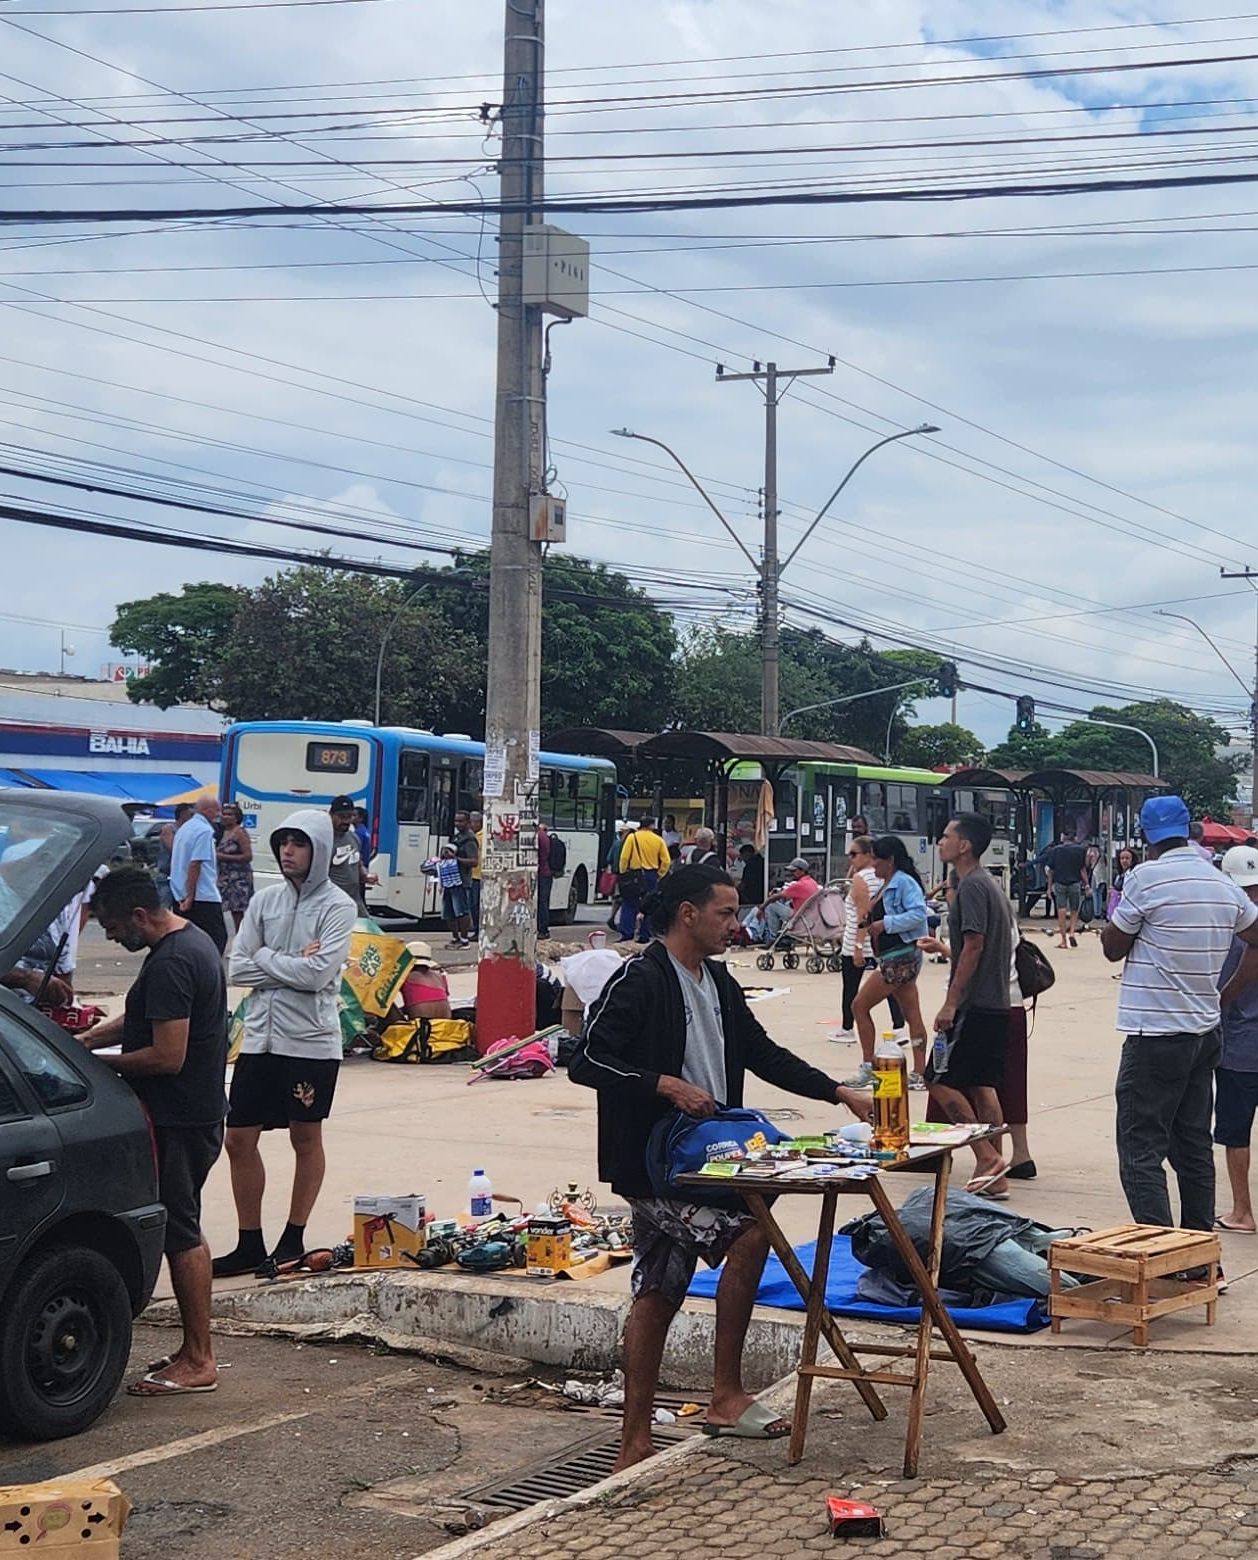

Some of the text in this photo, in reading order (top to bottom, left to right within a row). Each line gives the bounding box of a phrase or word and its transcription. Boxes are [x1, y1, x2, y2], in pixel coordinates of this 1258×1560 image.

[89, 735, 151, 755] BAHIA
[321, 750, 347, 765] 873
[360, 944, 378, 974] APAE
[366, 955, 382, 978] CAP
